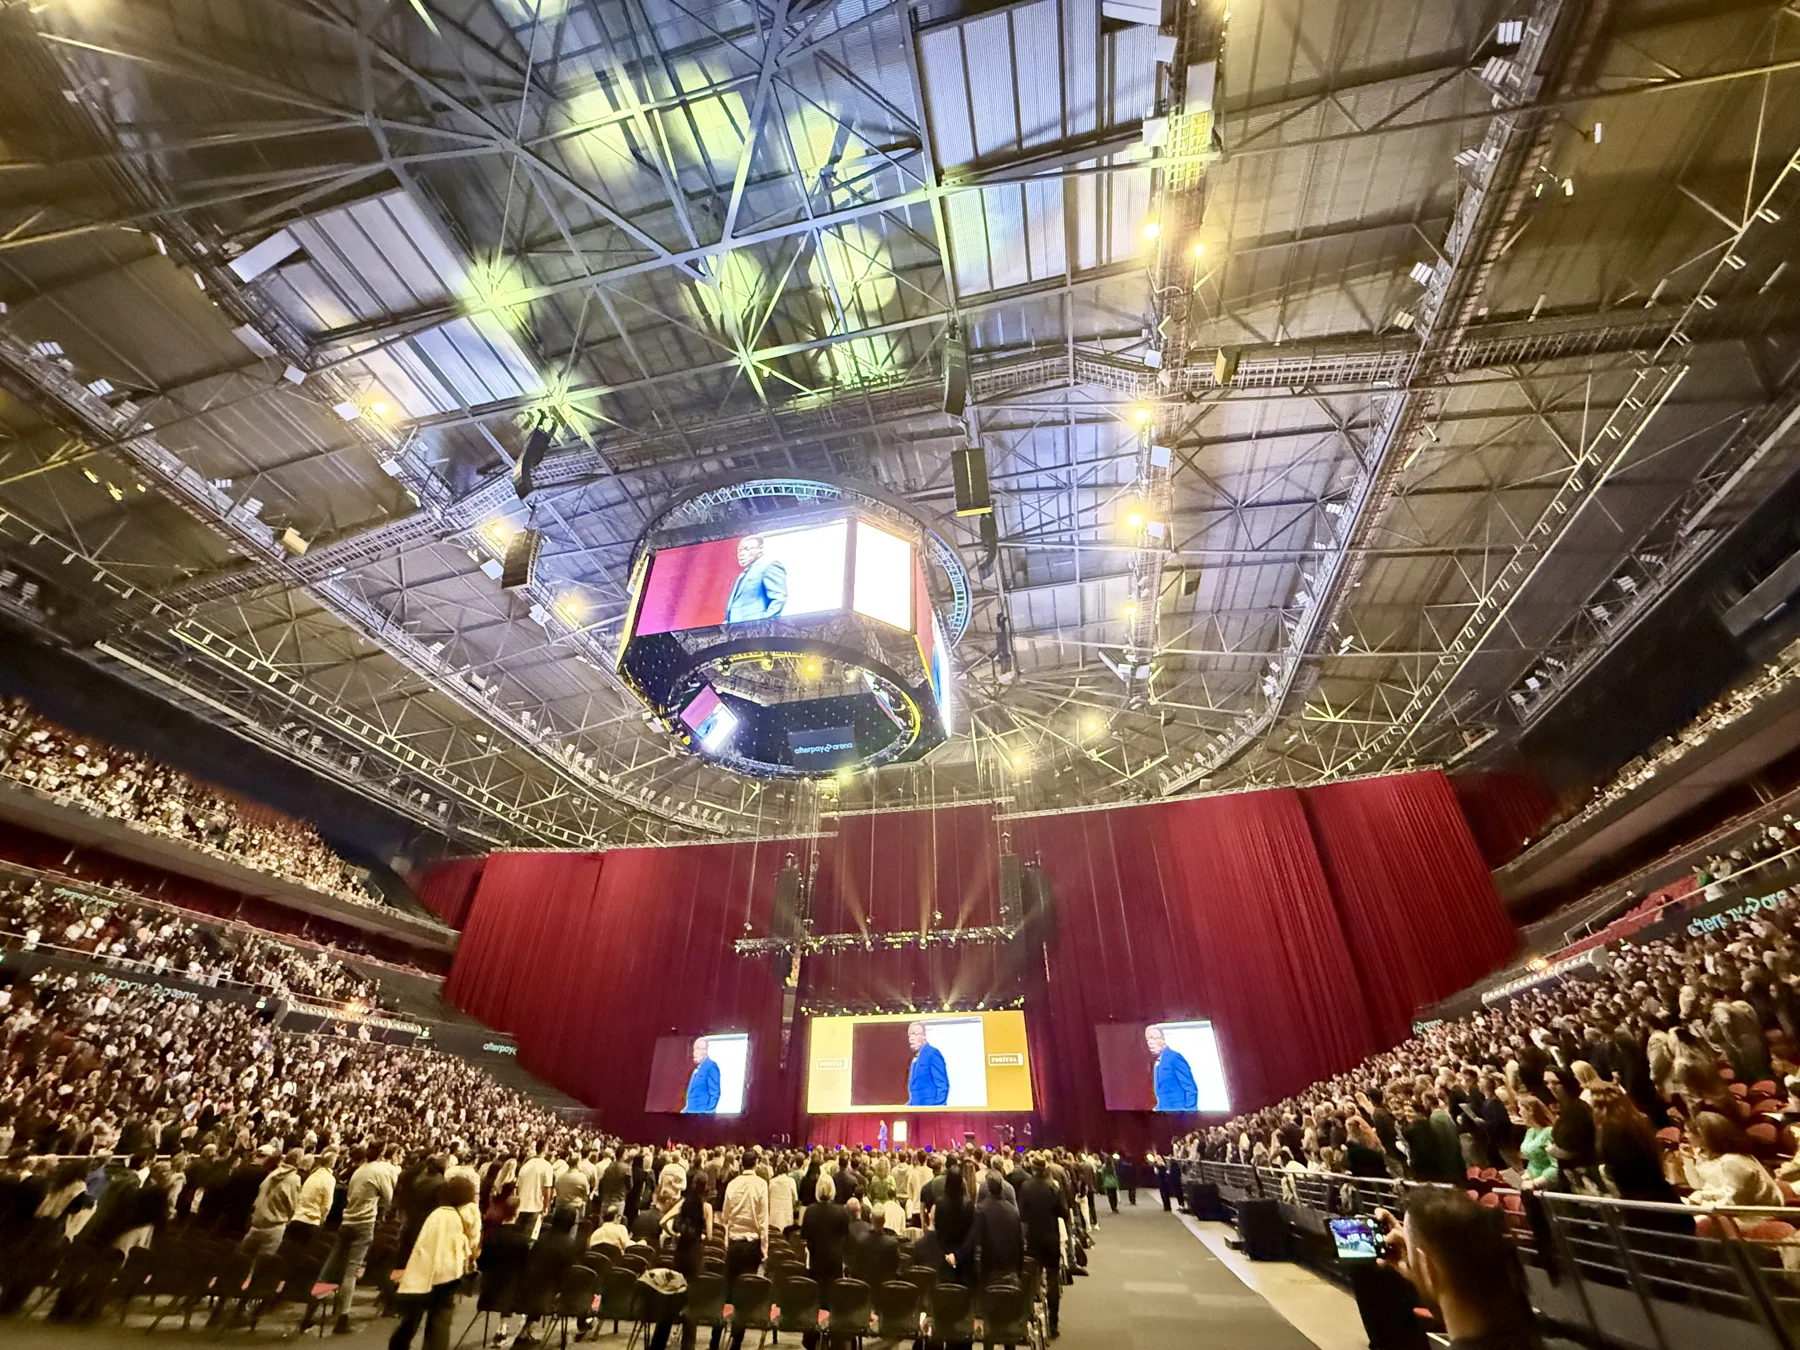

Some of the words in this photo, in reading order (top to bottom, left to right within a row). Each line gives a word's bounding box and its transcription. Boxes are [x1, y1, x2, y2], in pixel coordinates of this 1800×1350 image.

[794, 745, 824, 755] afterpay
[832, 742, 854, 751] arena
[482, 1041, 515, 1056] afterpay
